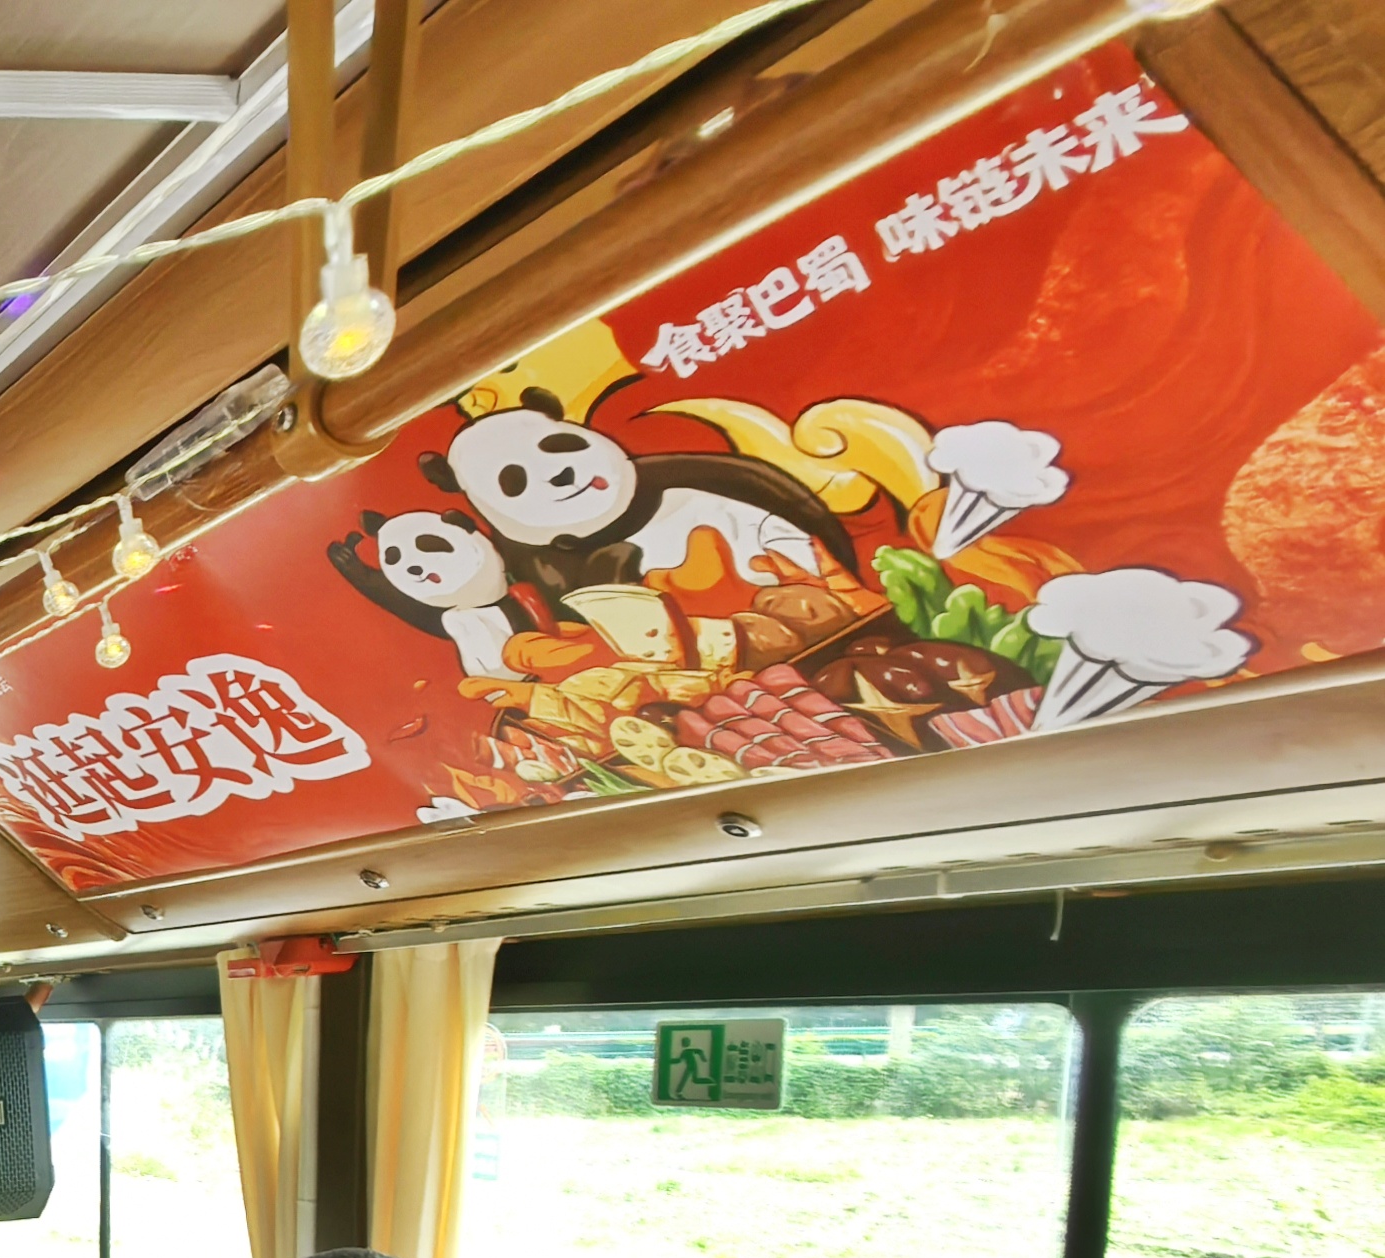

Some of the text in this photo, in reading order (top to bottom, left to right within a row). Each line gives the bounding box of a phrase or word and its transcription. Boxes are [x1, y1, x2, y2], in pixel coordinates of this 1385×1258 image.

[639, 79, 1191, 379] 食聚巴蜀 味链未来
